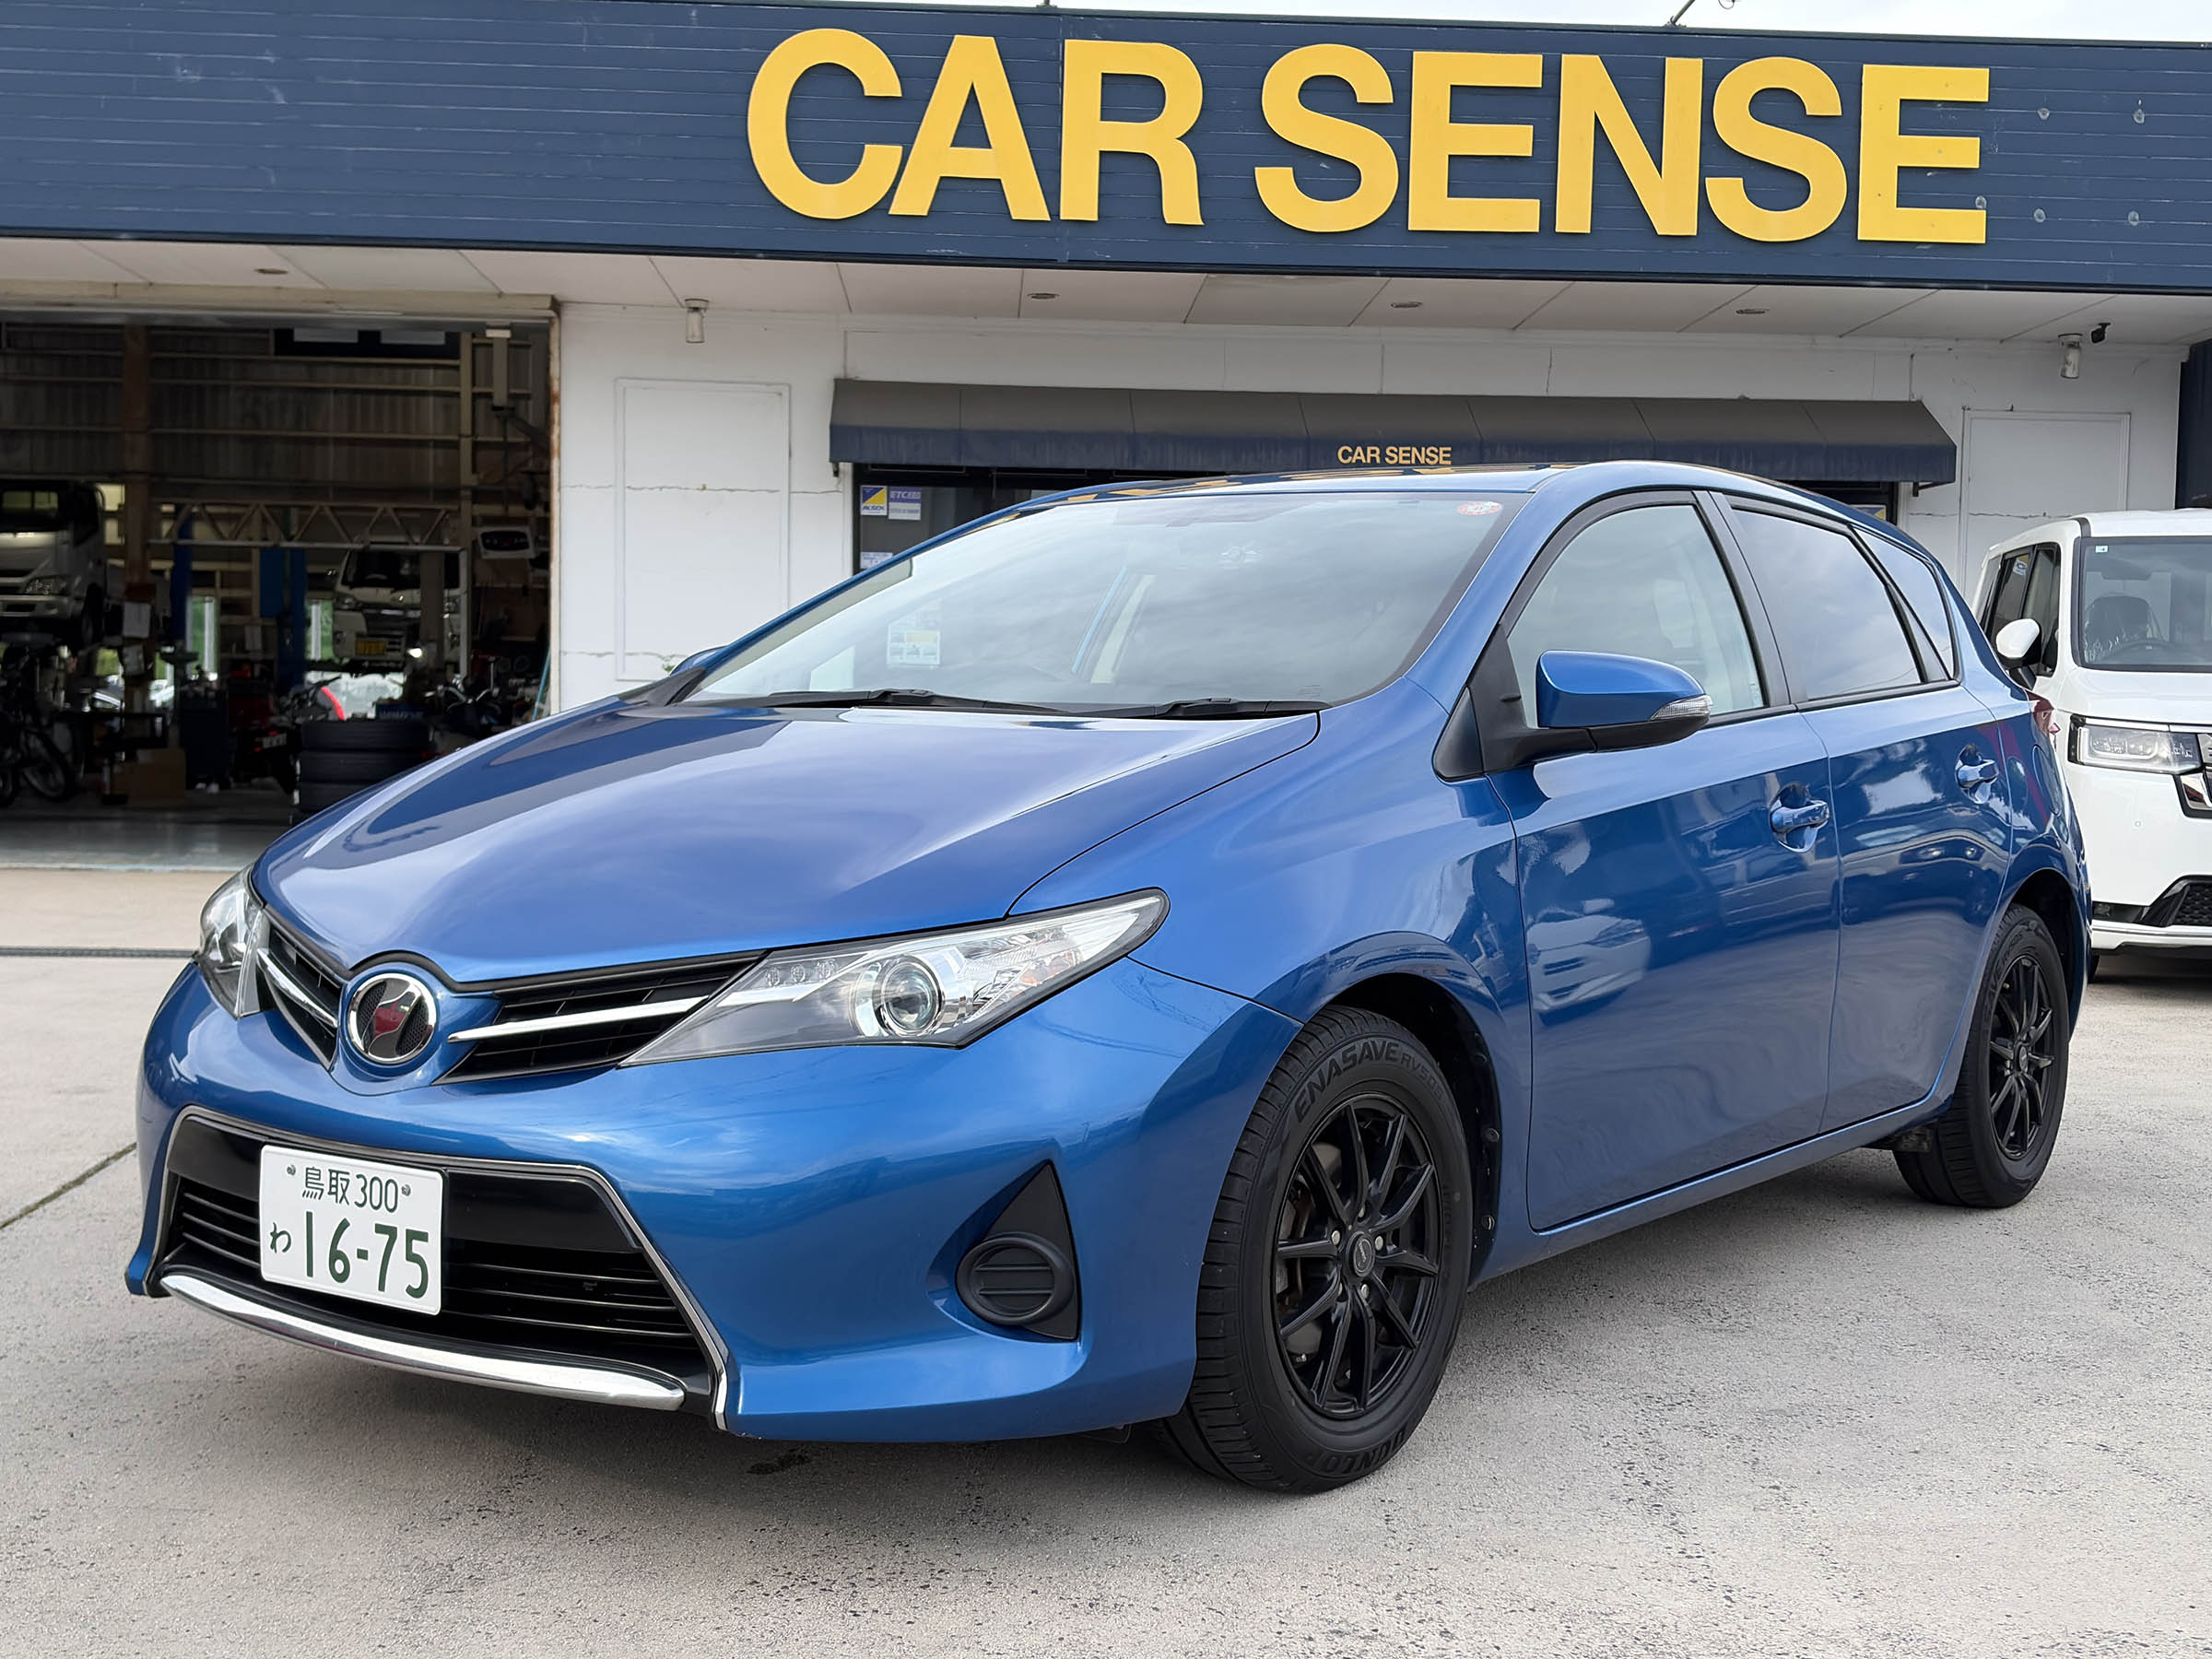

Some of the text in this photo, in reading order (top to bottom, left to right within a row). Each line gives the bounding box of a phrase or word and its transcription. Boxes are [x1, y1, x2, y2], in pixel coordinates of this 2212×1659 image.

[747, 28, 1990, 244] CAR SENSE
[1337, 445, 1453, 465] CAR SENSE
[1294, 1040, 1400, 1123] ENASAVE
[269, 1210, 429, 1299] わ 16-75
